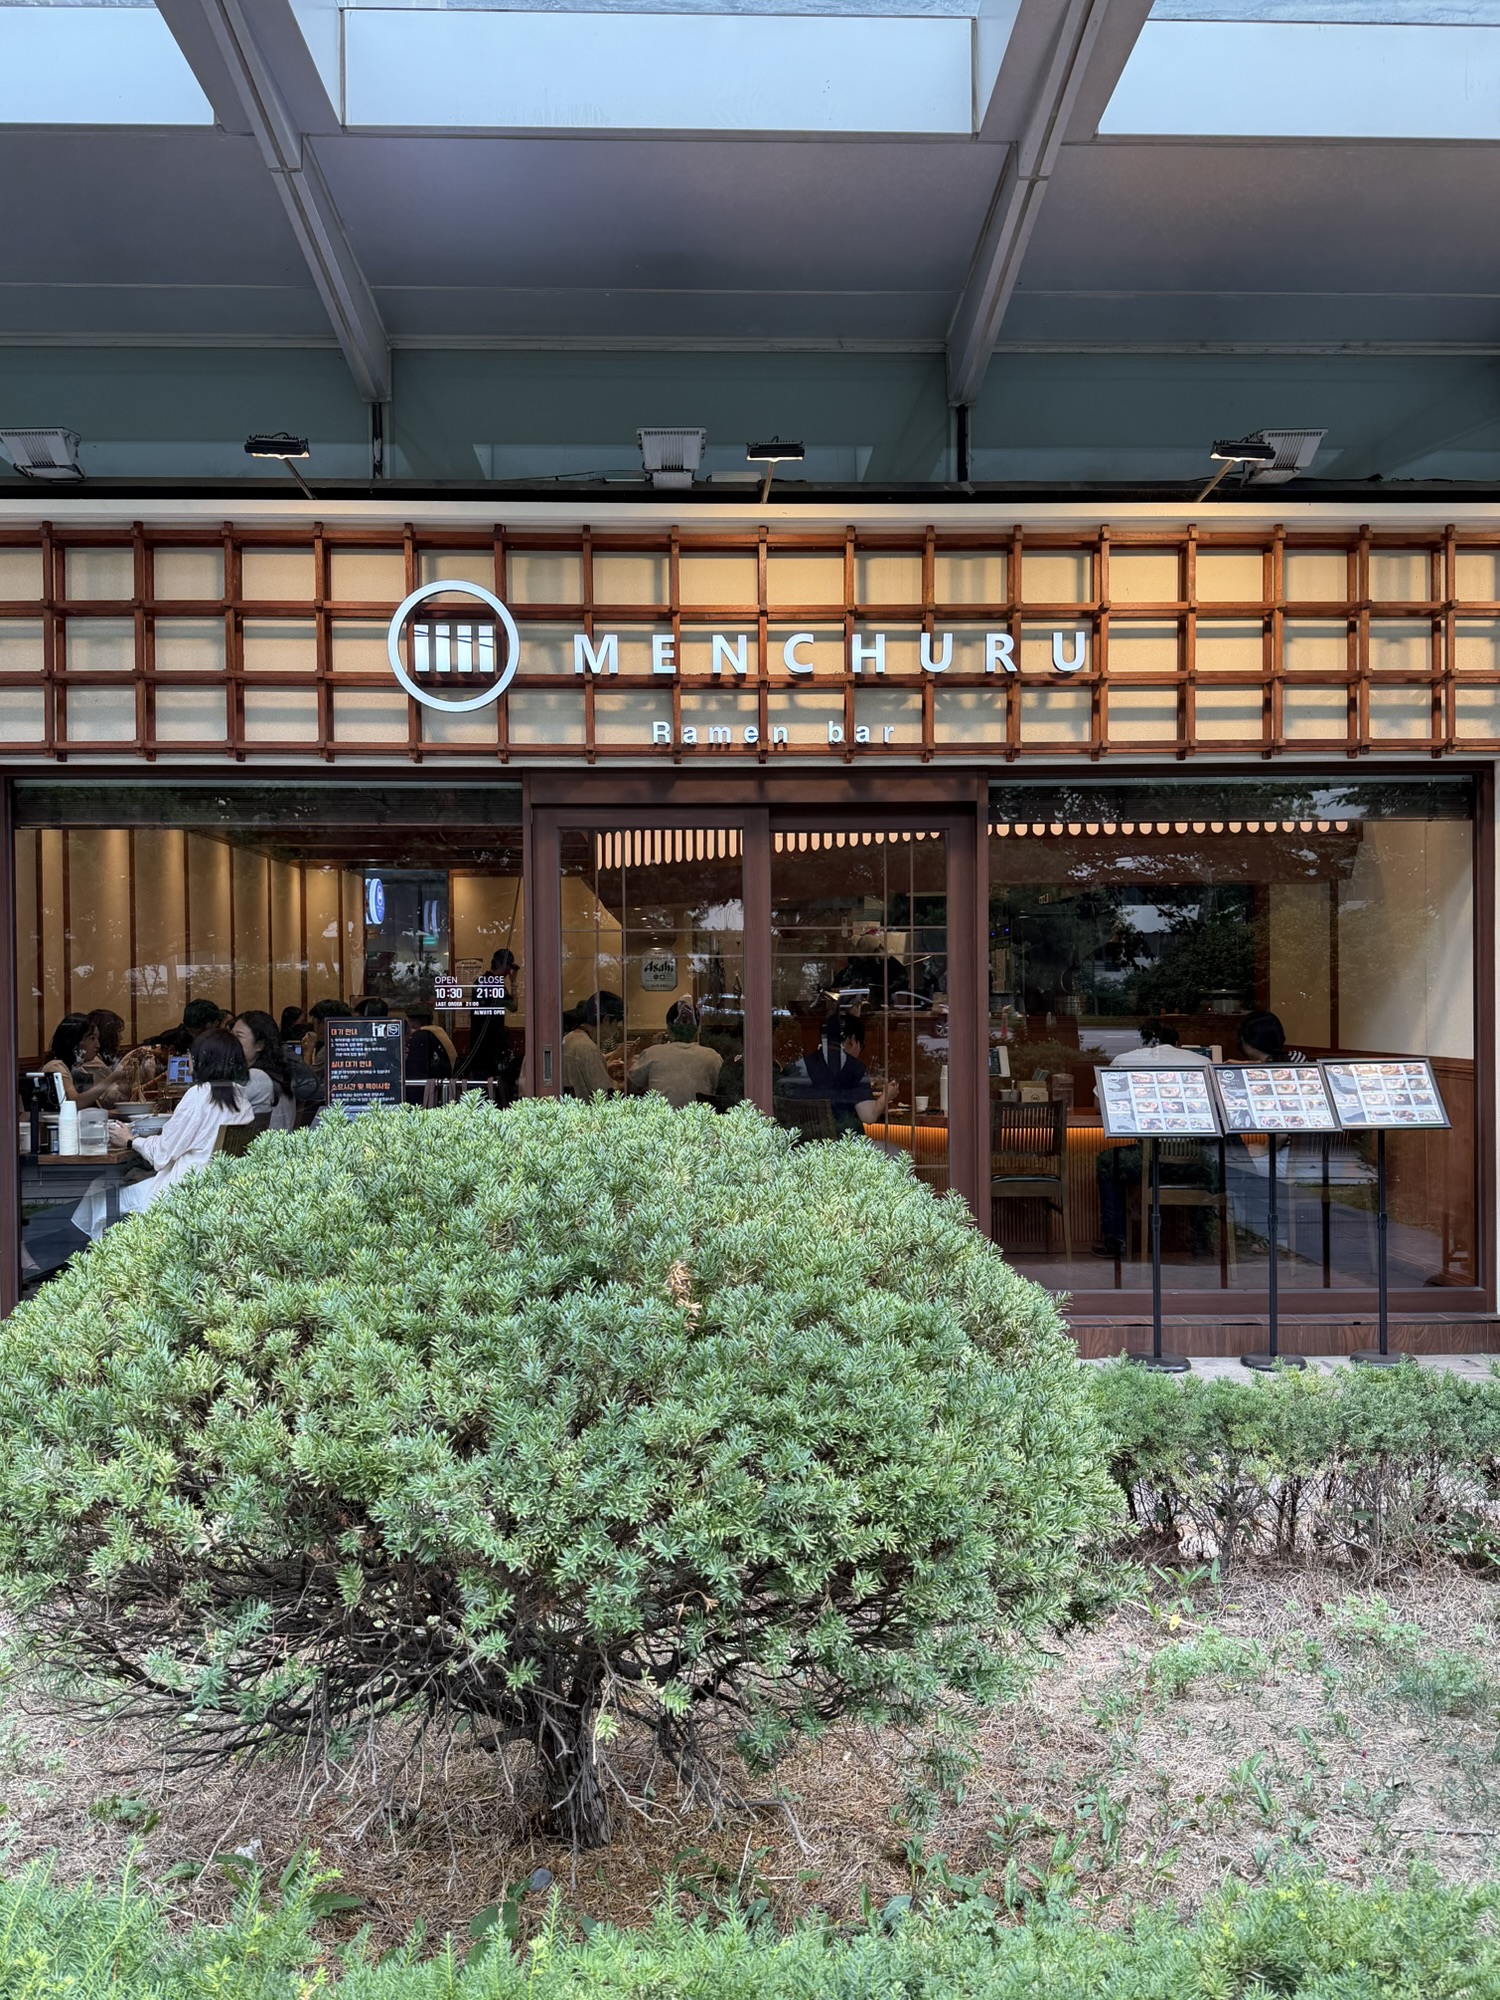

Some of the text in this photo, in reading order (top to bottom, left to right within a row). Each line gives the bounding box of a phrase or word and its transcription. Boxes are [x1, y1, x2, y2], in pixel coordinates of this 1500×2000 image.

[573, 630, 1087, 675] MENCHURU
[652, 720, 895, 745] Ramen bar
[644, 960, 674, 973] Asahi
[434, 975, 505, 984] OPEN CLOSE
[434, 987, 505, 999] 10:30 21:00
